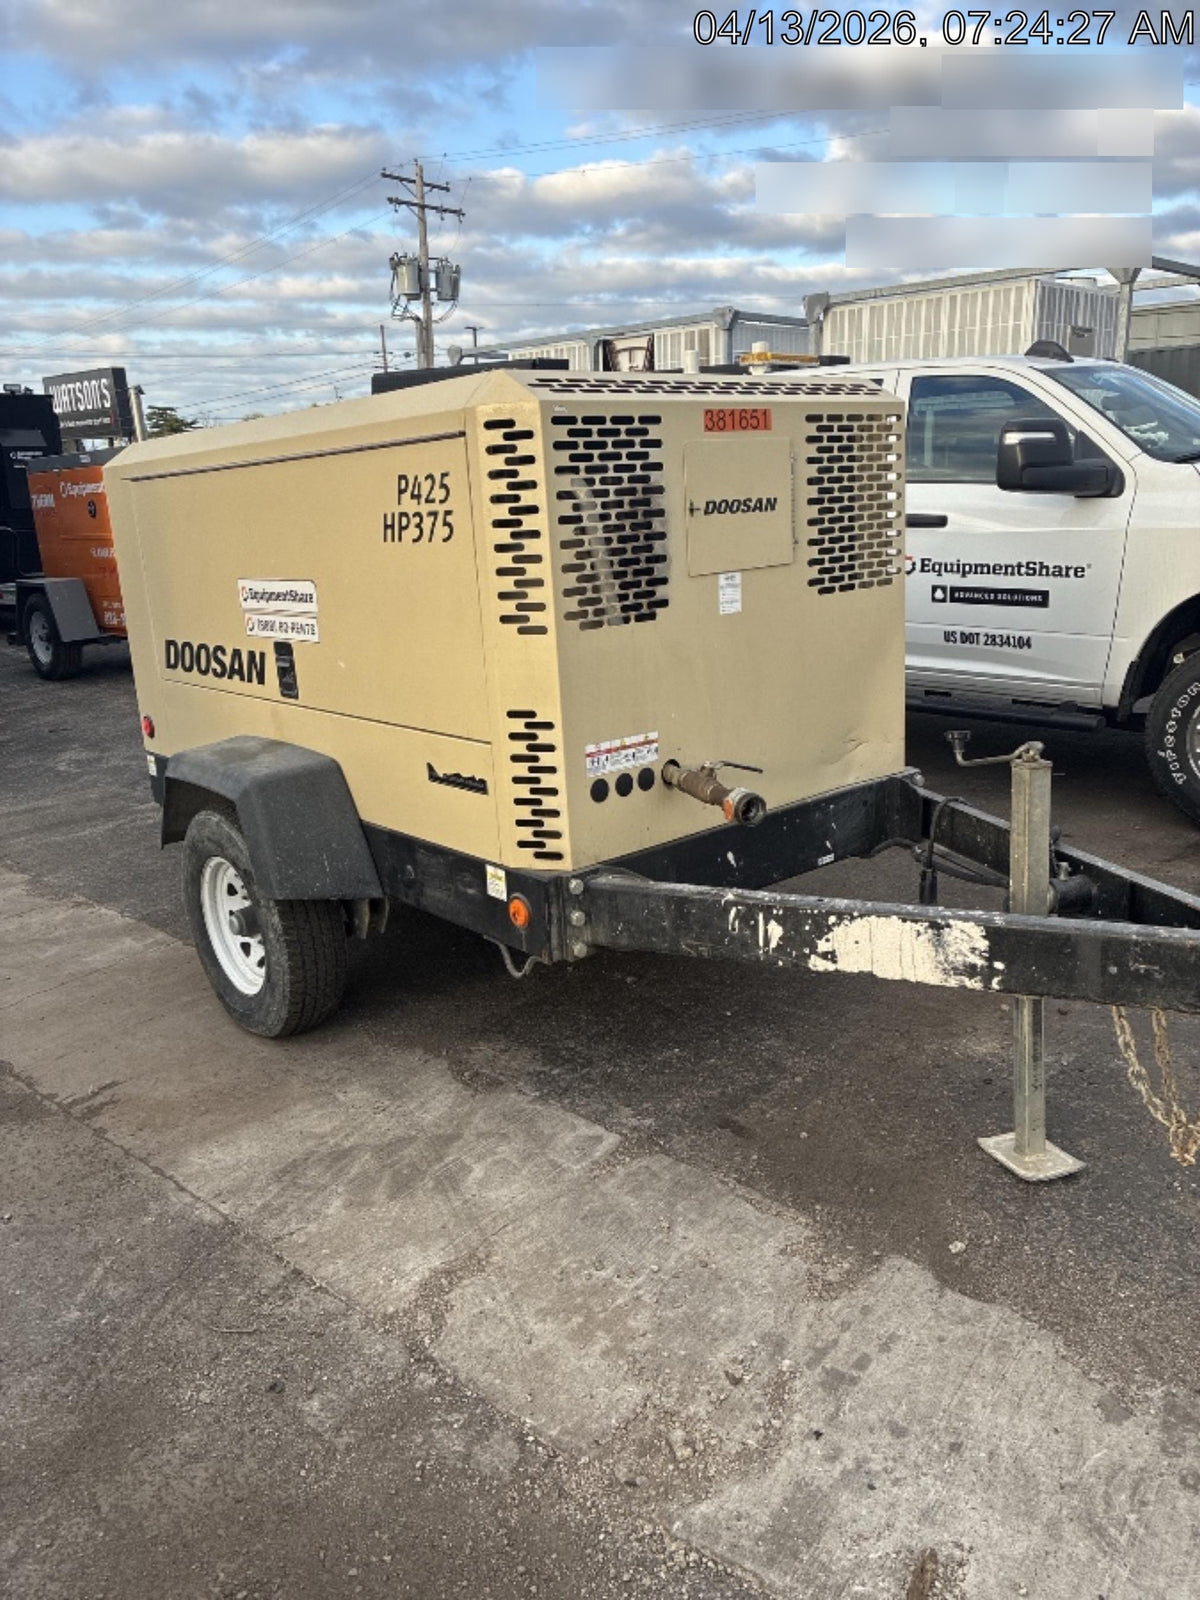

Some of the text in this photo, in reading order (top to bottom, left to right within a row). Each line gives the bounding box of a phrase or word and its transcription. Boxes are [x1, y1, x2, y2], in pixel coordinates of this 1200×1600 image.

[705, 409, 768, 431] 381651
[397, 471, 451, 506] P425
[703, 497, 778, 516] DOOSAN
[383, 509, 454, 543] HP375
[943, 631, 1032, 650] US DOT 2834104
[165, 639, 266, 685] DOOSAN
